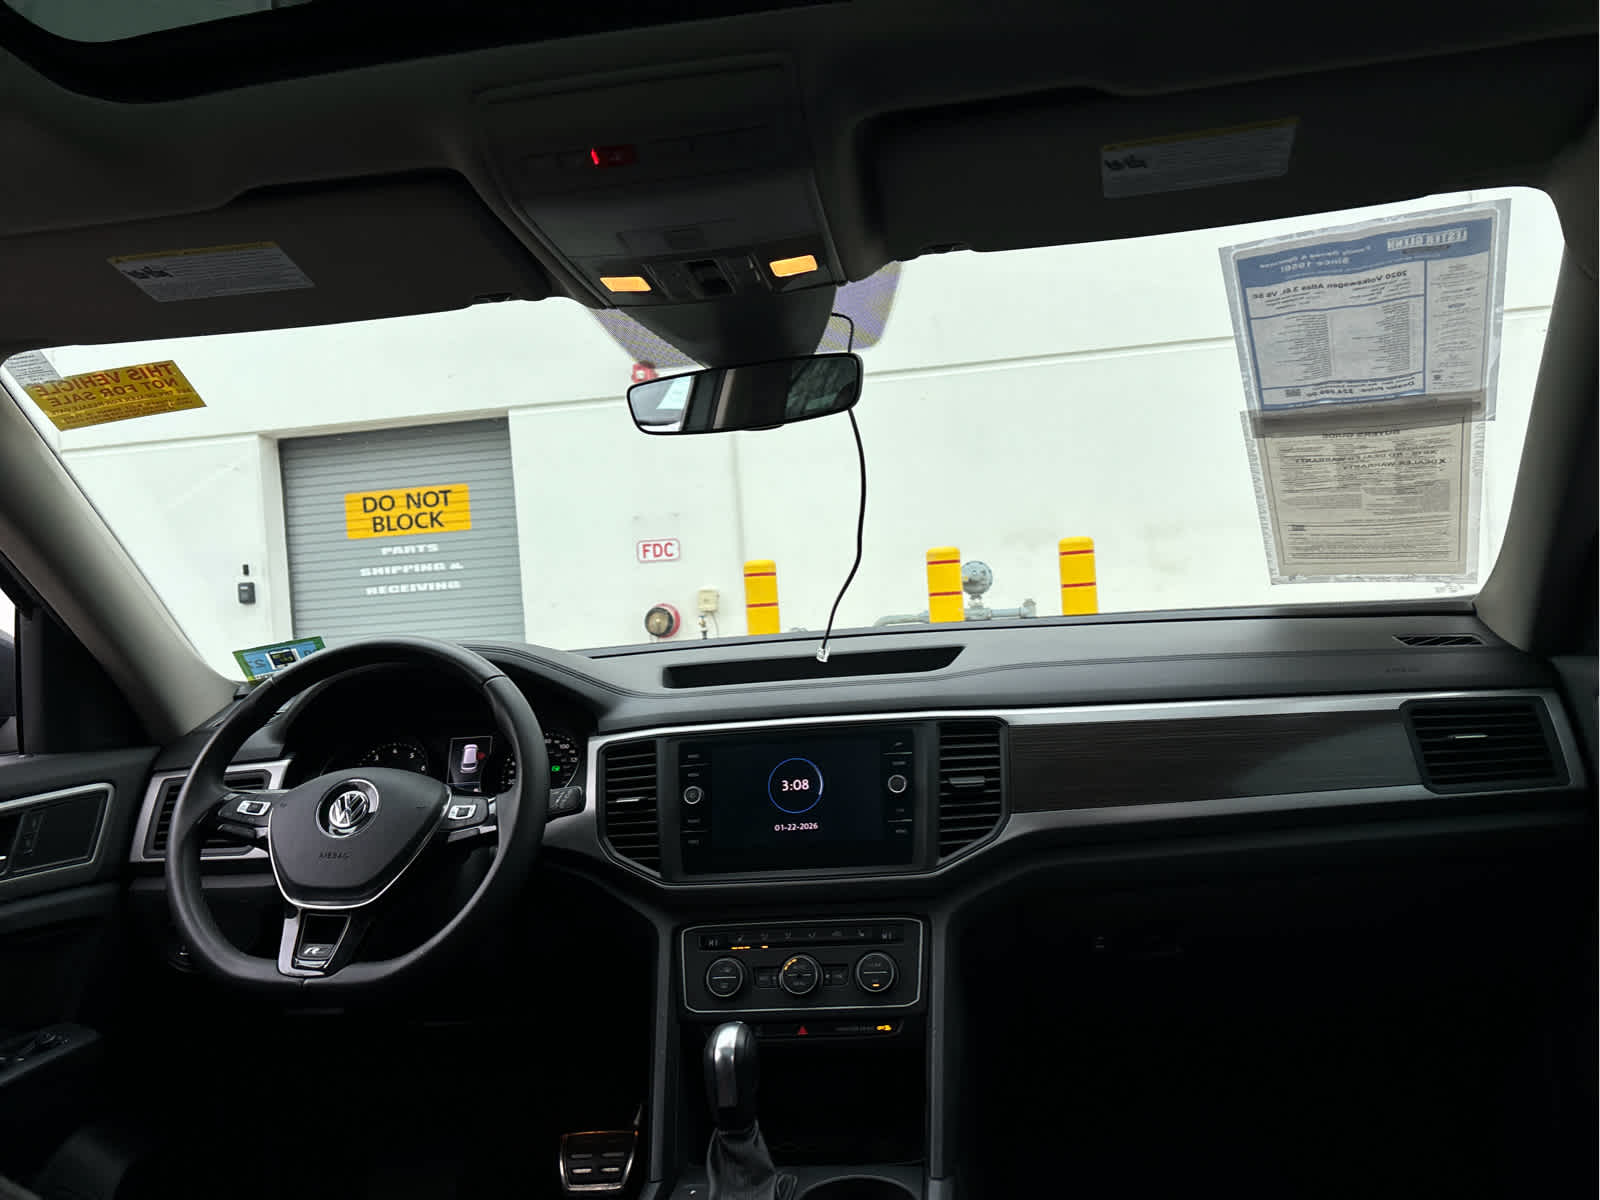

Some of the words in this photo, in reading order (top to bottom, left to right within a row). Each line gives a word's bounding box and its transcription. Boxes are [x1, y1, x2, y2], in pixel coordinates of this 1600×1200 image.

[362, 495, 396, 513] DO
[405, 489, 452, 510] NOT
[372, 510, 445, 533] BLOCK
[381, 543, 439, 555] PARTS
[642, 542, 675, 559] FDC
[360, 562, 446, 576] SHIPPING
[449, 562, 464, 570] &
[365, 580, 461, 595] RECEIVING
[781, 779, 810, 792] 3:08
[774, 822, 819, 832] 01-22-2026
